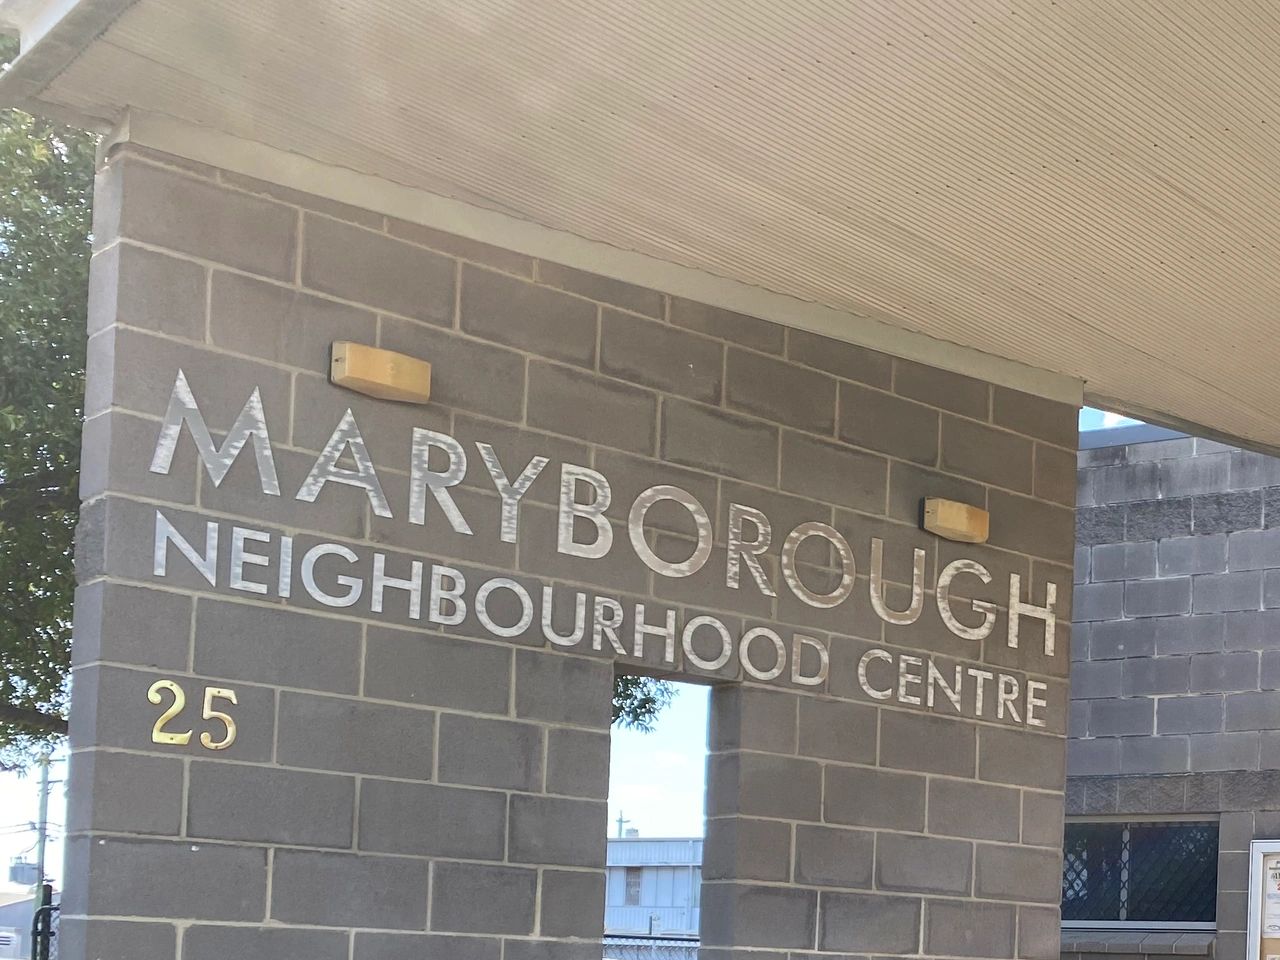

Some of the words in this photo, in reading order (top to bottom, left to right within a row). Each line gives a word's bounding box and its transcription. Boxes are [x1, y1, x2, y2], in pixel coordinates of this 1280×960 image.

[149, 367, 1058, 657] MARYBOROUGH
[152, 510, 831, 687] NEIGHBOURHOOD
[857, 648, 1049, 728] CENTRE
[147, 679, 238, 751] 25
